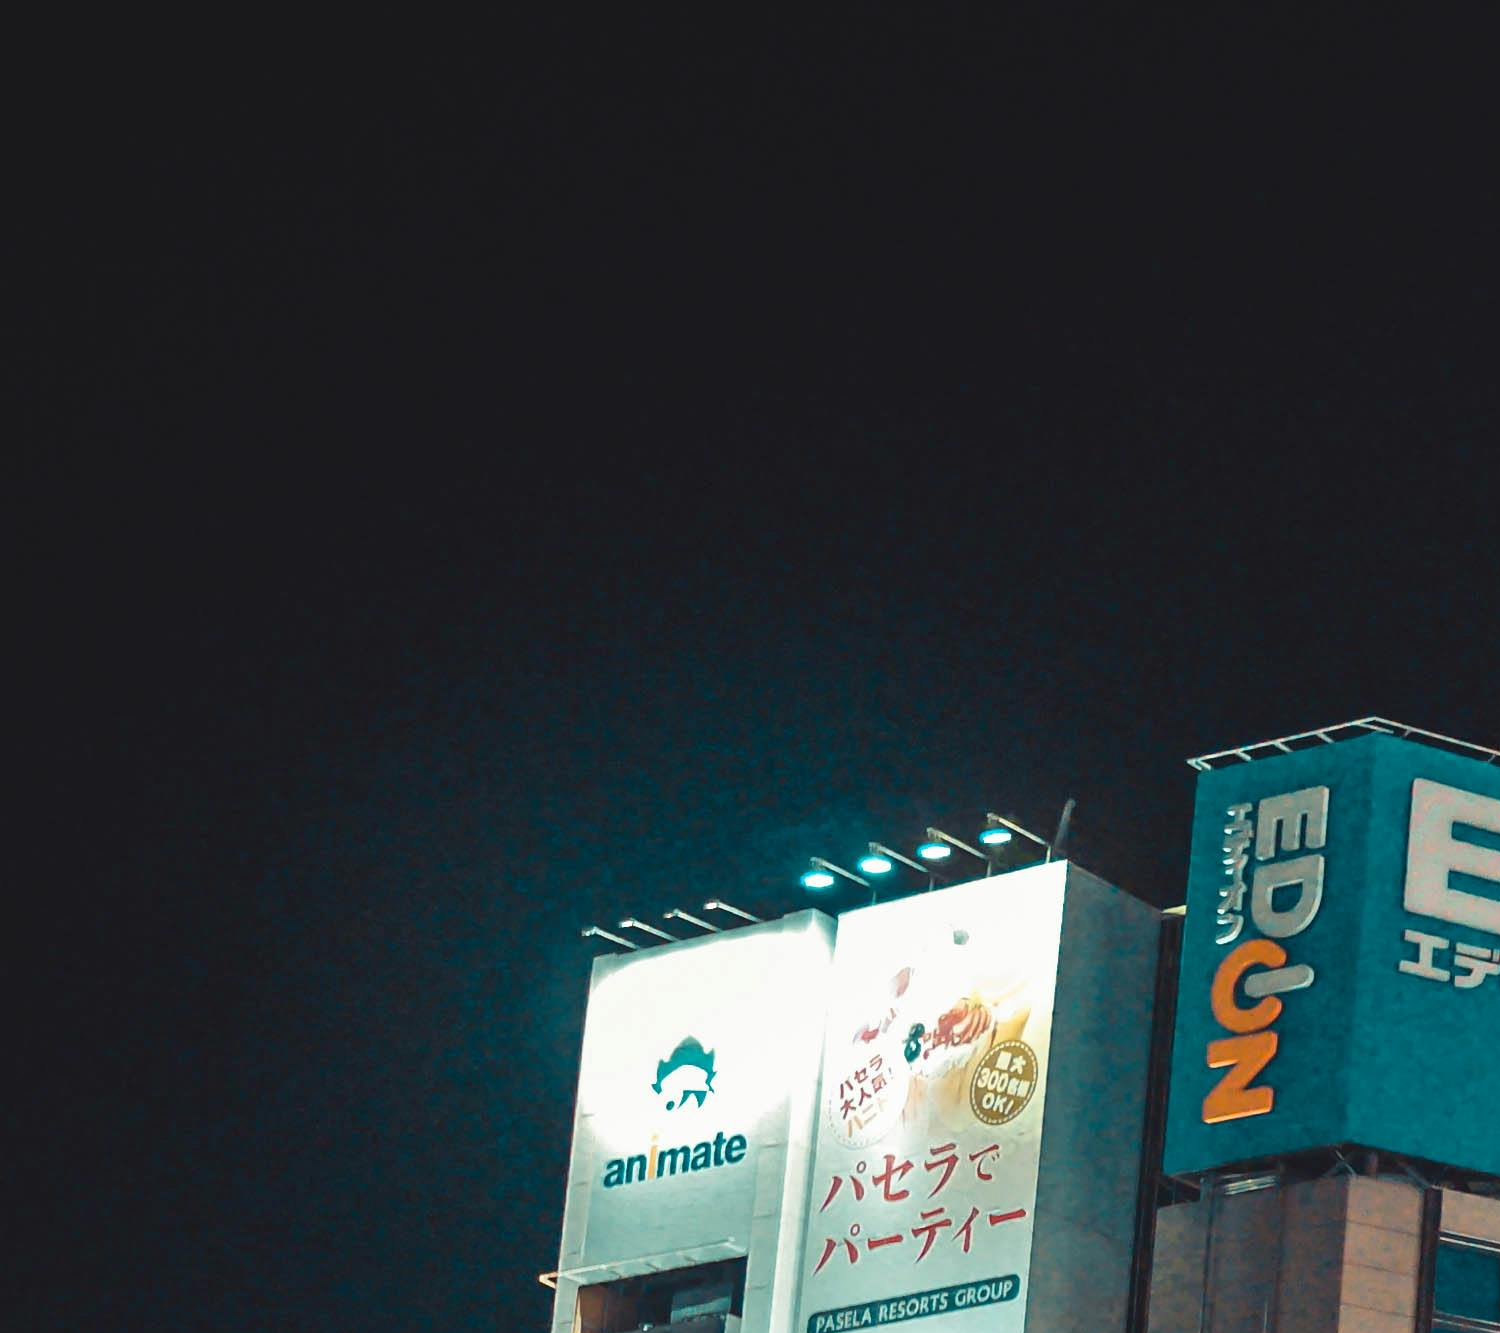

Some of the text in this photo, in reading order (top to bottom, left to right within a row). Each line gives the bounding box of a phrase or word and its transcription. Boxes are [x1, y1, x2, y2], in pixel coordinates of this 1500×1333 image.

[1202, 785, 1331, 1125] EDION
[982, 1091, 1015, 1115] OK!
[602, 1129, 748, 1190] animate
[819, 1142, 1000, 1213] パセラで
[812, 1206, 1027, 1277] パーティー
[878, 1292, 949, 1321] RESORTS
[954, 1279, 1013, 1306] GROUP
